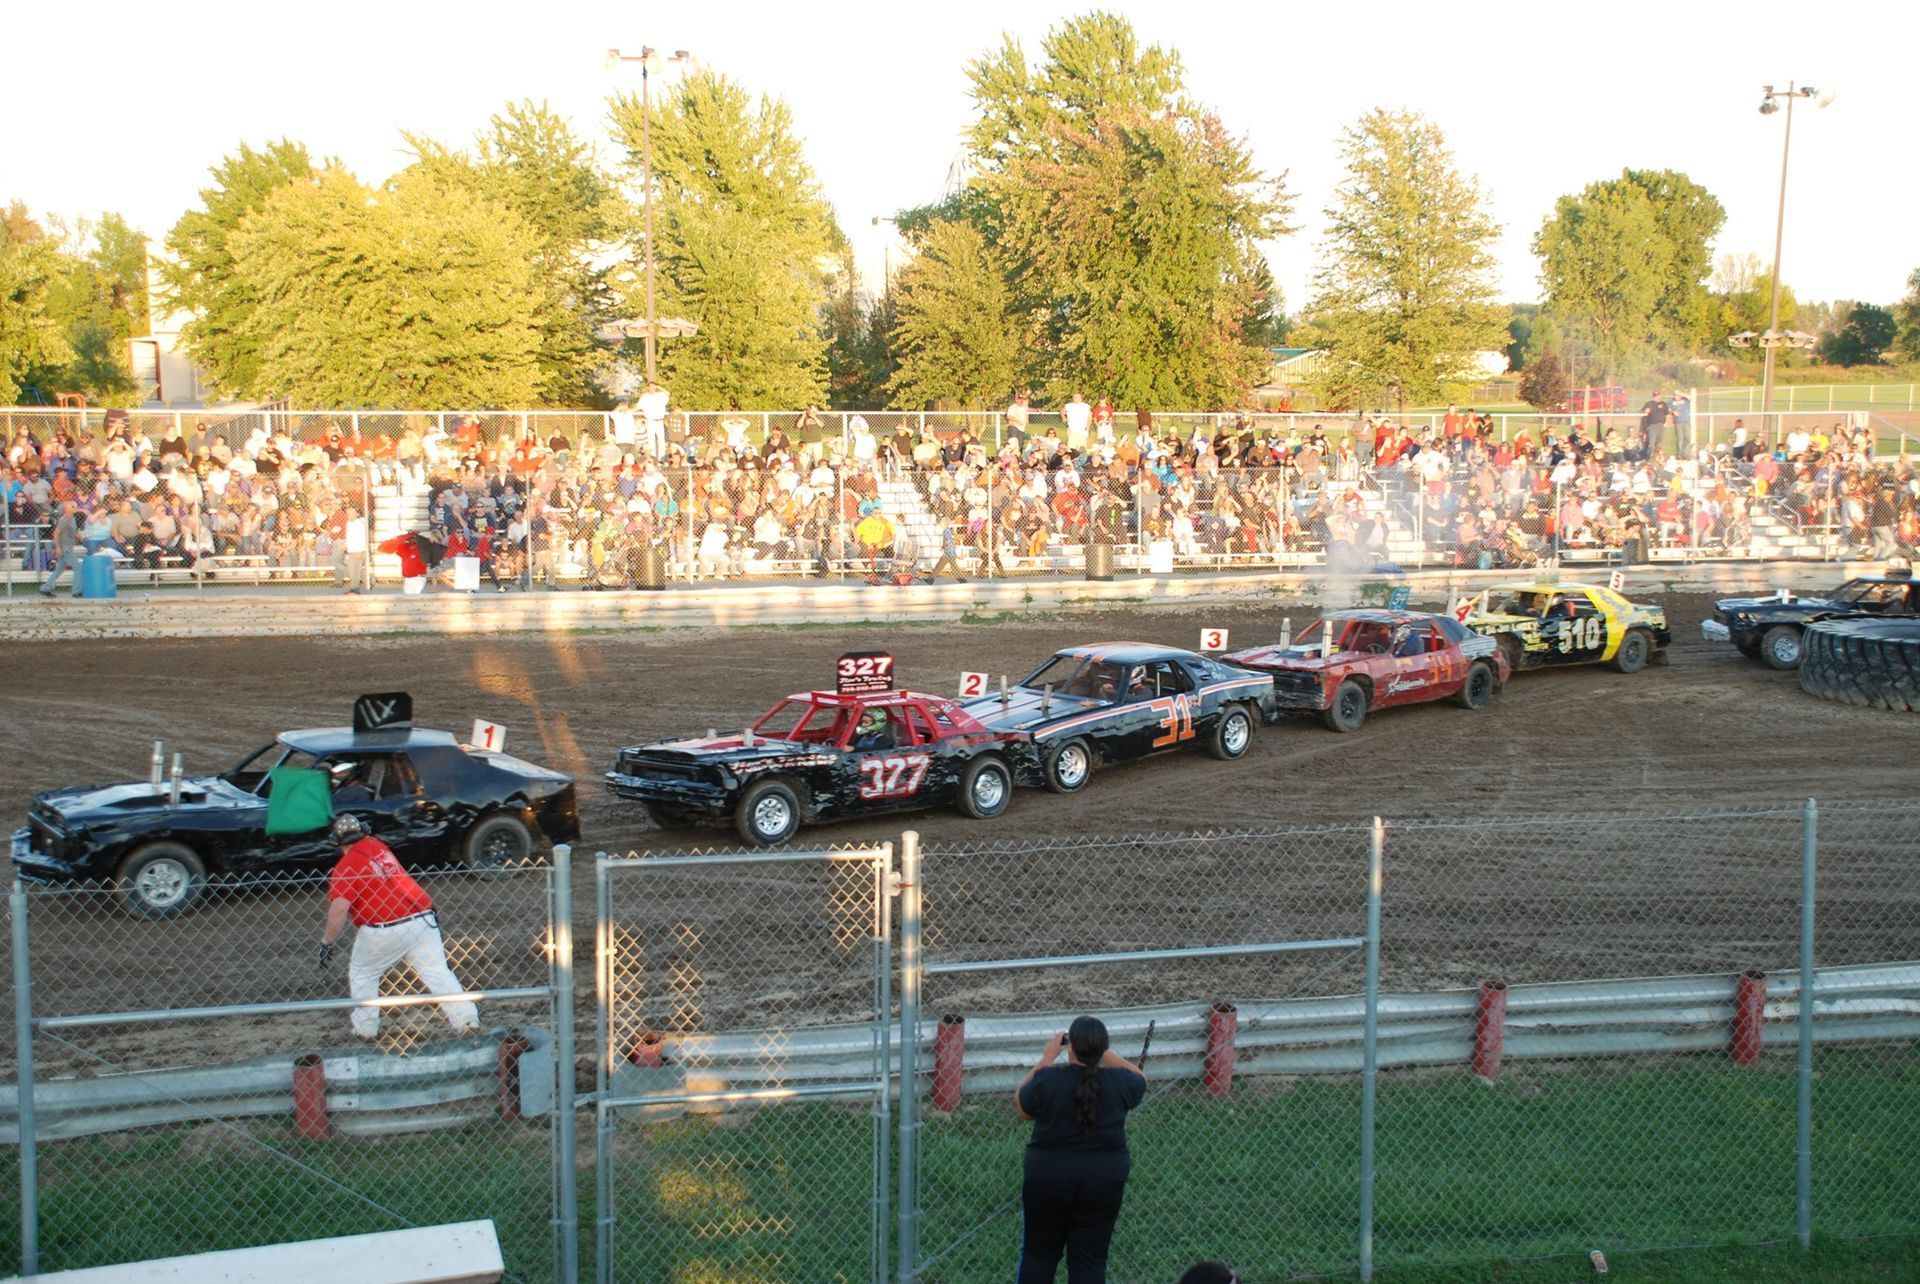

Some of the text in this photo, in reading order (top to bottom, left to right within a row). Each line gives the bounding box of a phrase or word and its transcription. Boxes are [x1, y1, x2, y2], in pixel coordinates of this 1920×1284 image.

[1614, 573, 1621, 588] 5
[1455, 605, 1473, 624] 4
[1207, 631, 1221, 648] 3
[1558, 617, 1601, 654] 510
[838, 656, 894, 677] 327
[964, 674, 981, 695] 2
[1152, 693, 1196, 748] 31
[484, 724, 495, 748] 1
[860, 753, 930, 800] 327
